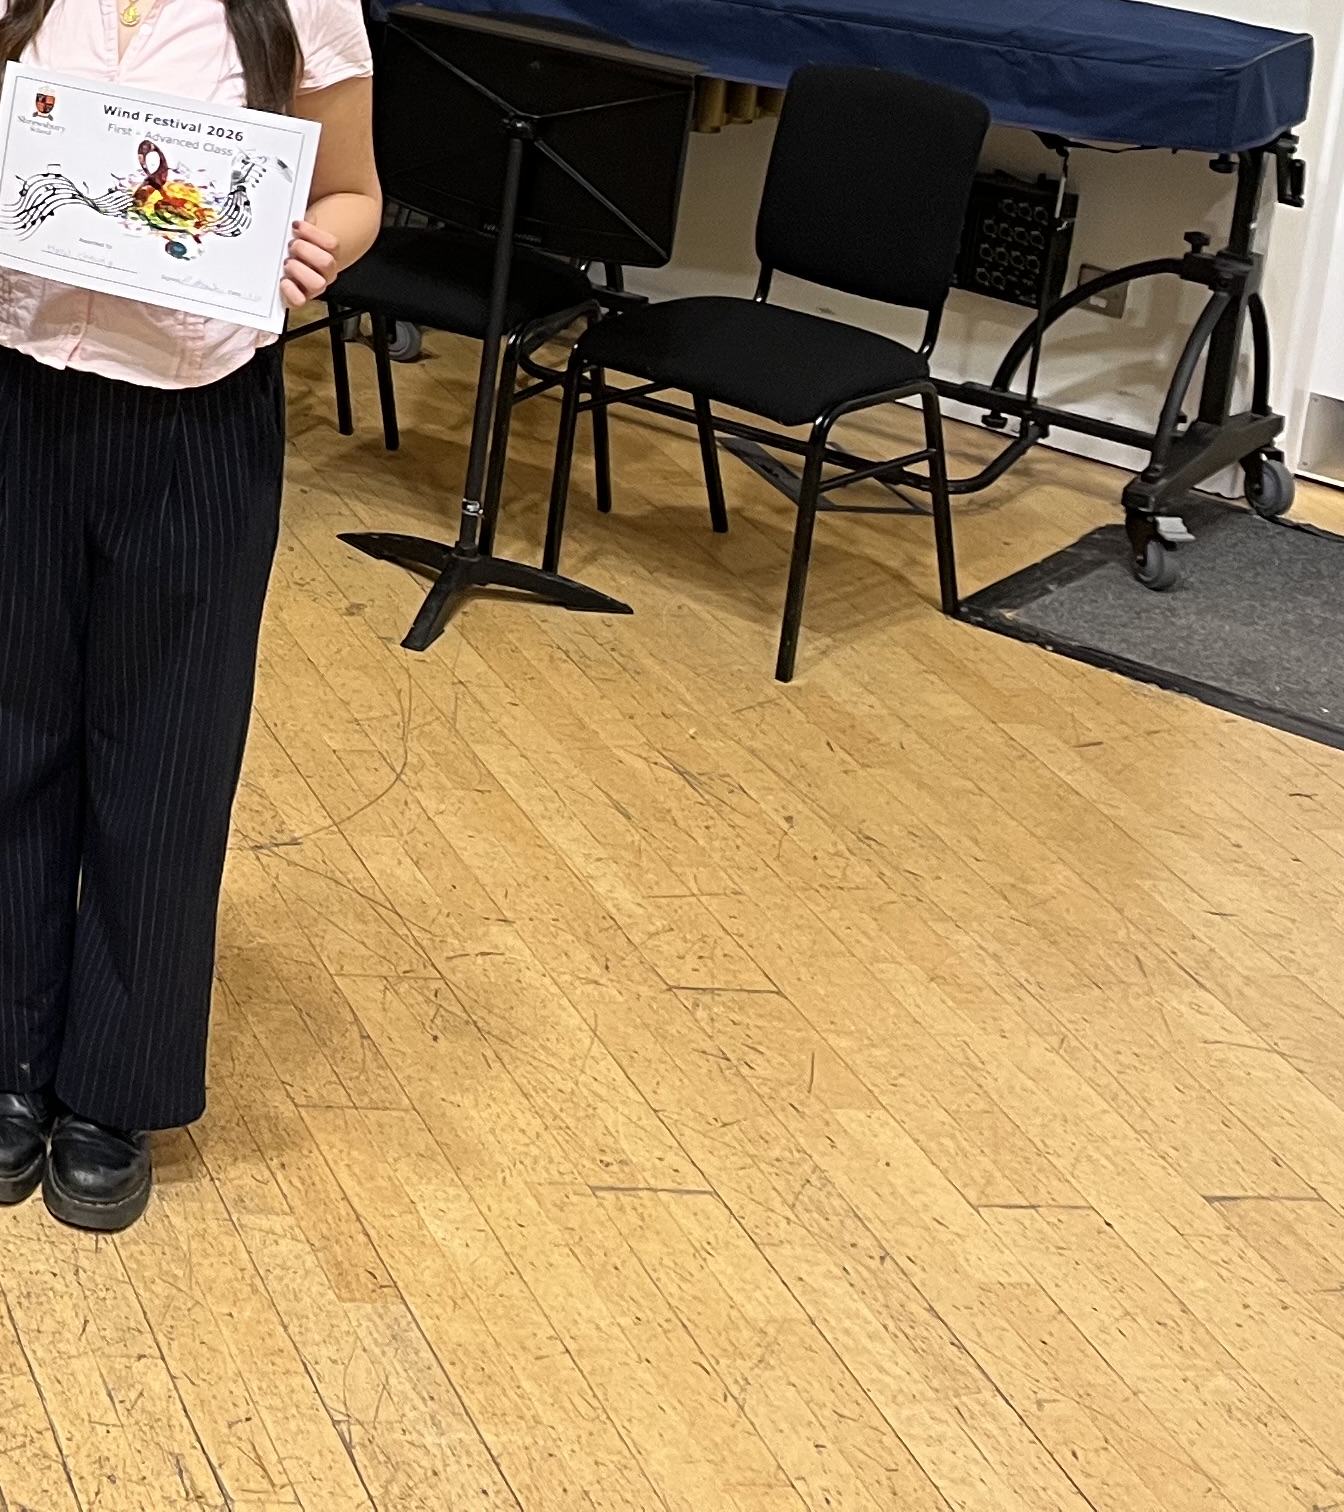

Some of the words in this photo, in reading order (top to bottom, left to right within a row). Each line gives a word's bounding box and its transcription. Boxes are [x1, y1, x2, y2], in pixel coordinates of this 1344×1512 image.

[103, 104, 140, 120] Wind
[144, 113, 202, 133] Festival
[206, 125, 244, 141] 2026
[107, 123, 133, 136] First
[145, 131, 200, 150] Advanced
[203, 142, 234, 157] Class
